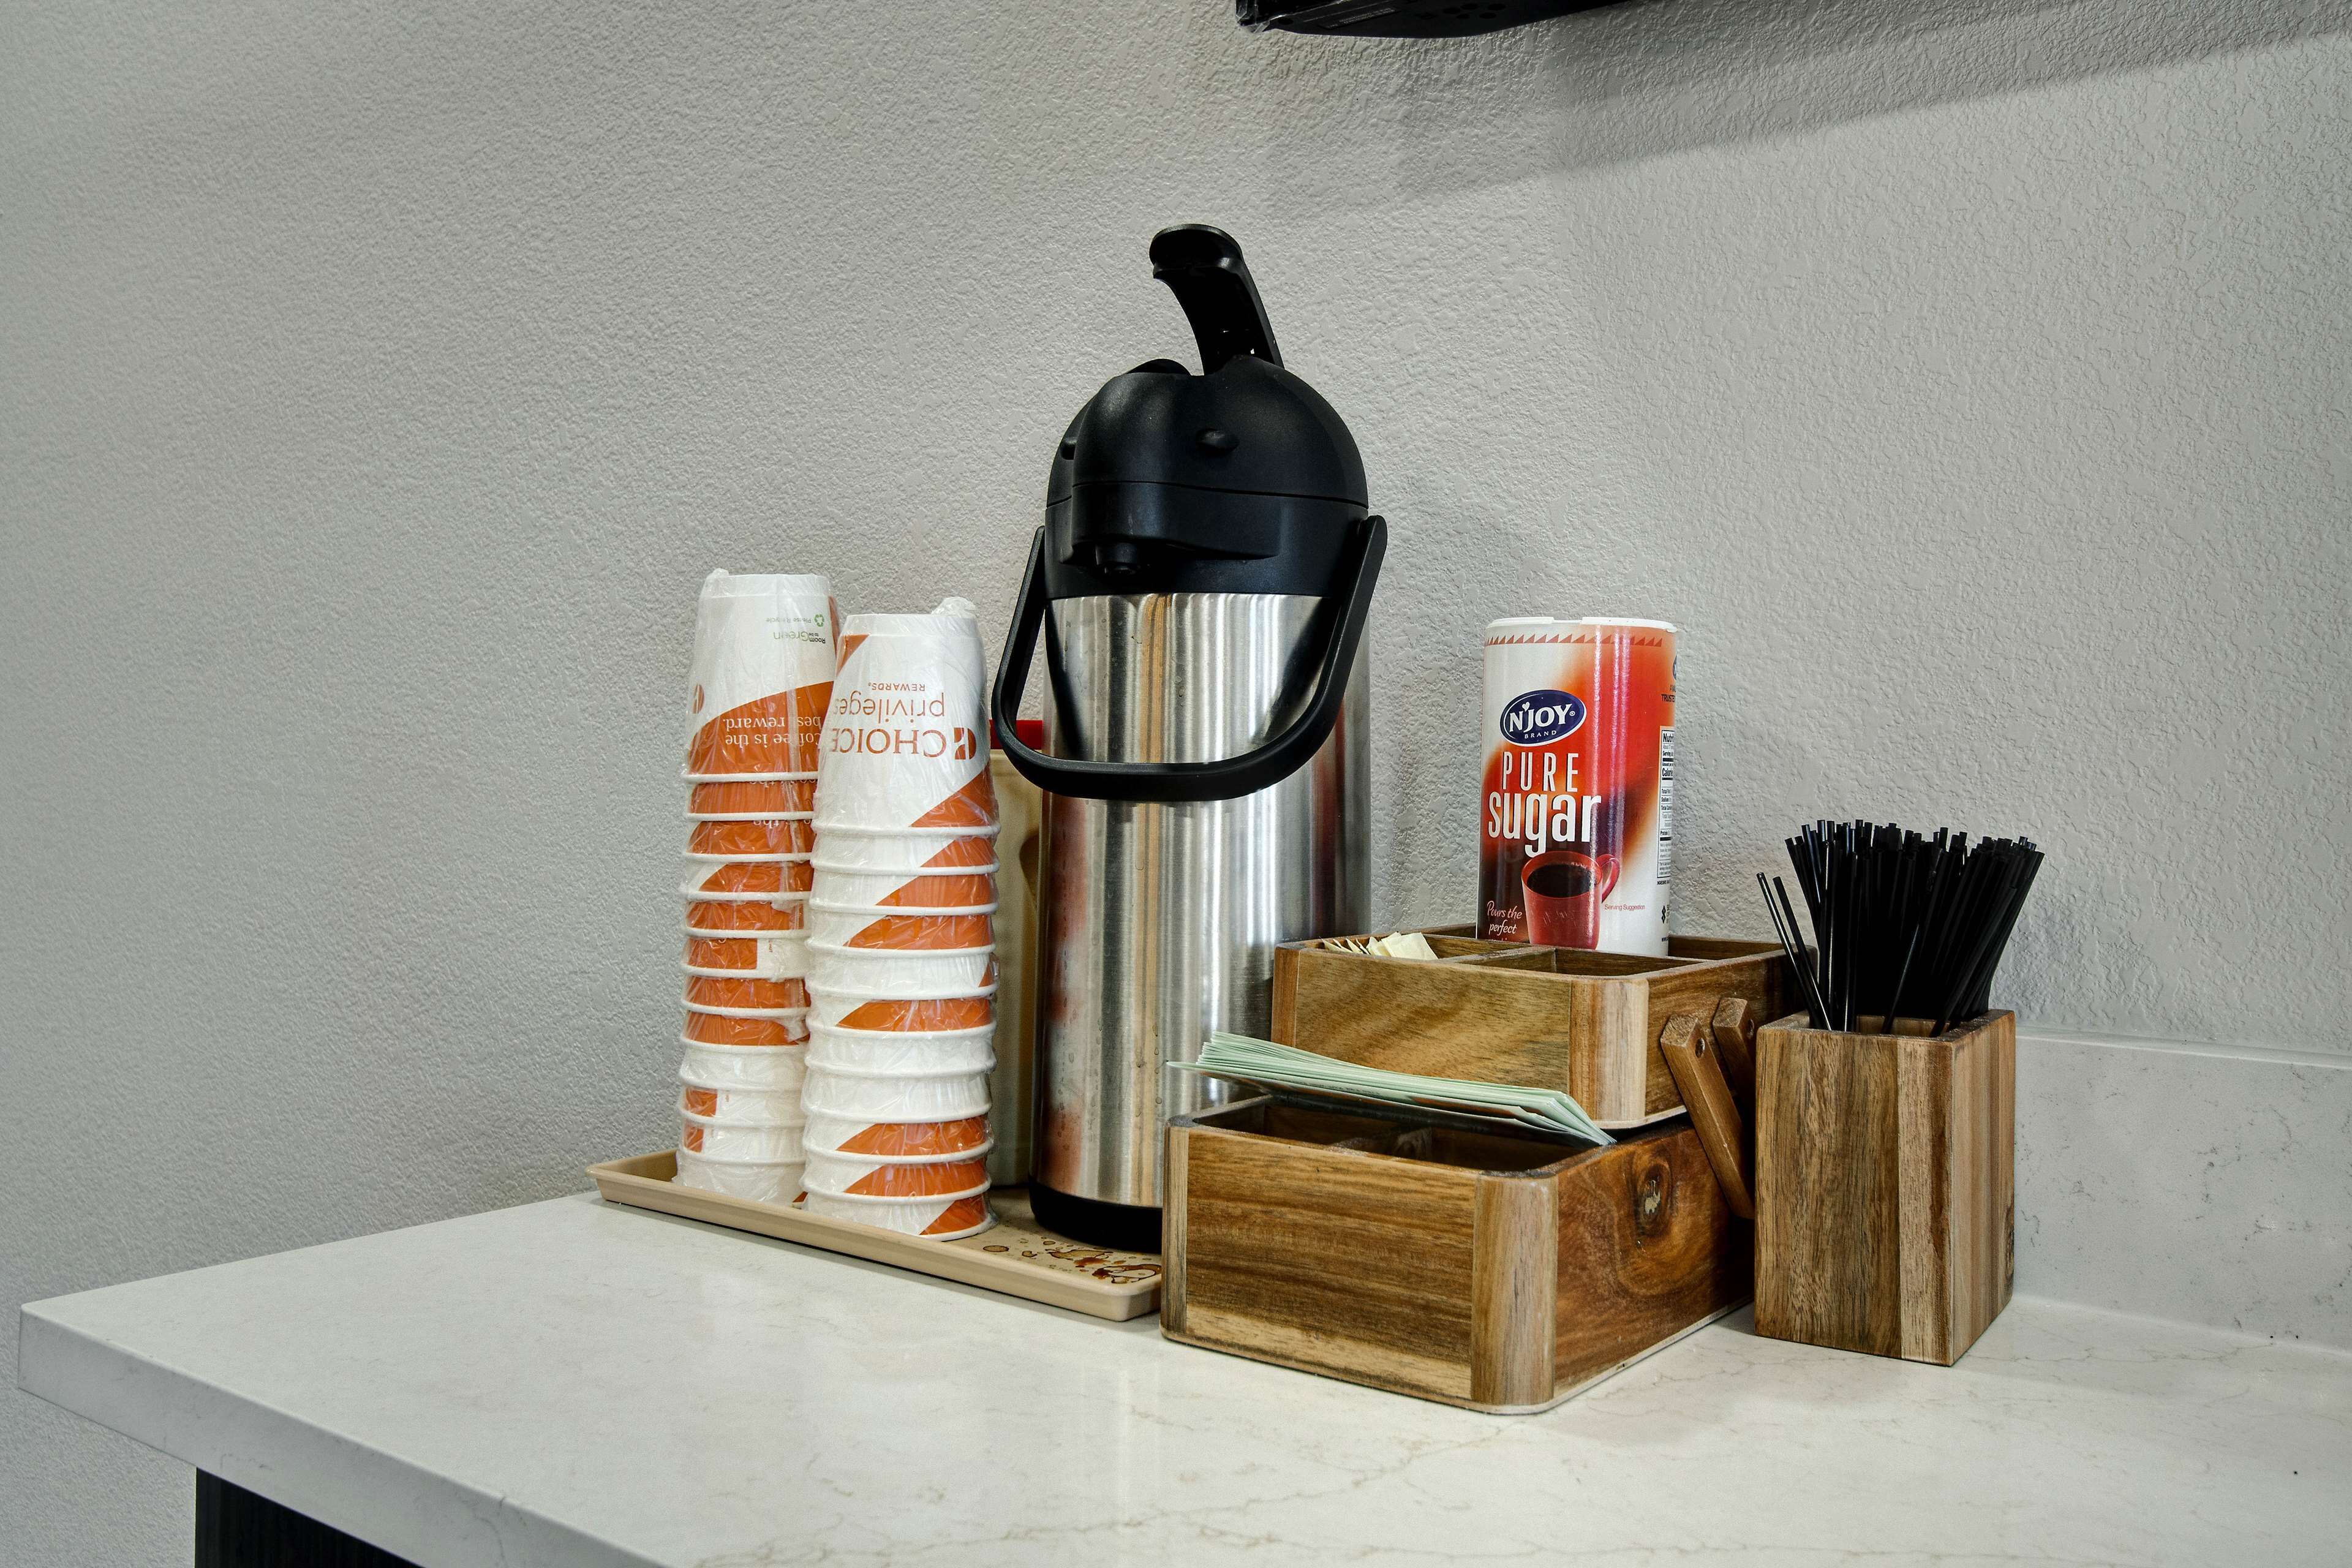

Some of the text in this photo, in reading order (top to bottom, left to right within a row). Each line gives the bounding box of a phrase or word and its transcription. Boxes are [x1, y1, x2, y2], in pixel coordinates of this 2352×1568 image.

[722, 716, 822, 731] bes reward.
[725, 732, 821, 748] Cofee is the
[832, 728, 947, 758] CHOICE
[1524, 730, 1557, 739] BRAND
[1502, 751, 1579, 793] PURE
[1488, 791, 1602, 858] sugar
[1487, 900, 1523, 920] Pours the
[1488, 919, 1518, 936] perfect
